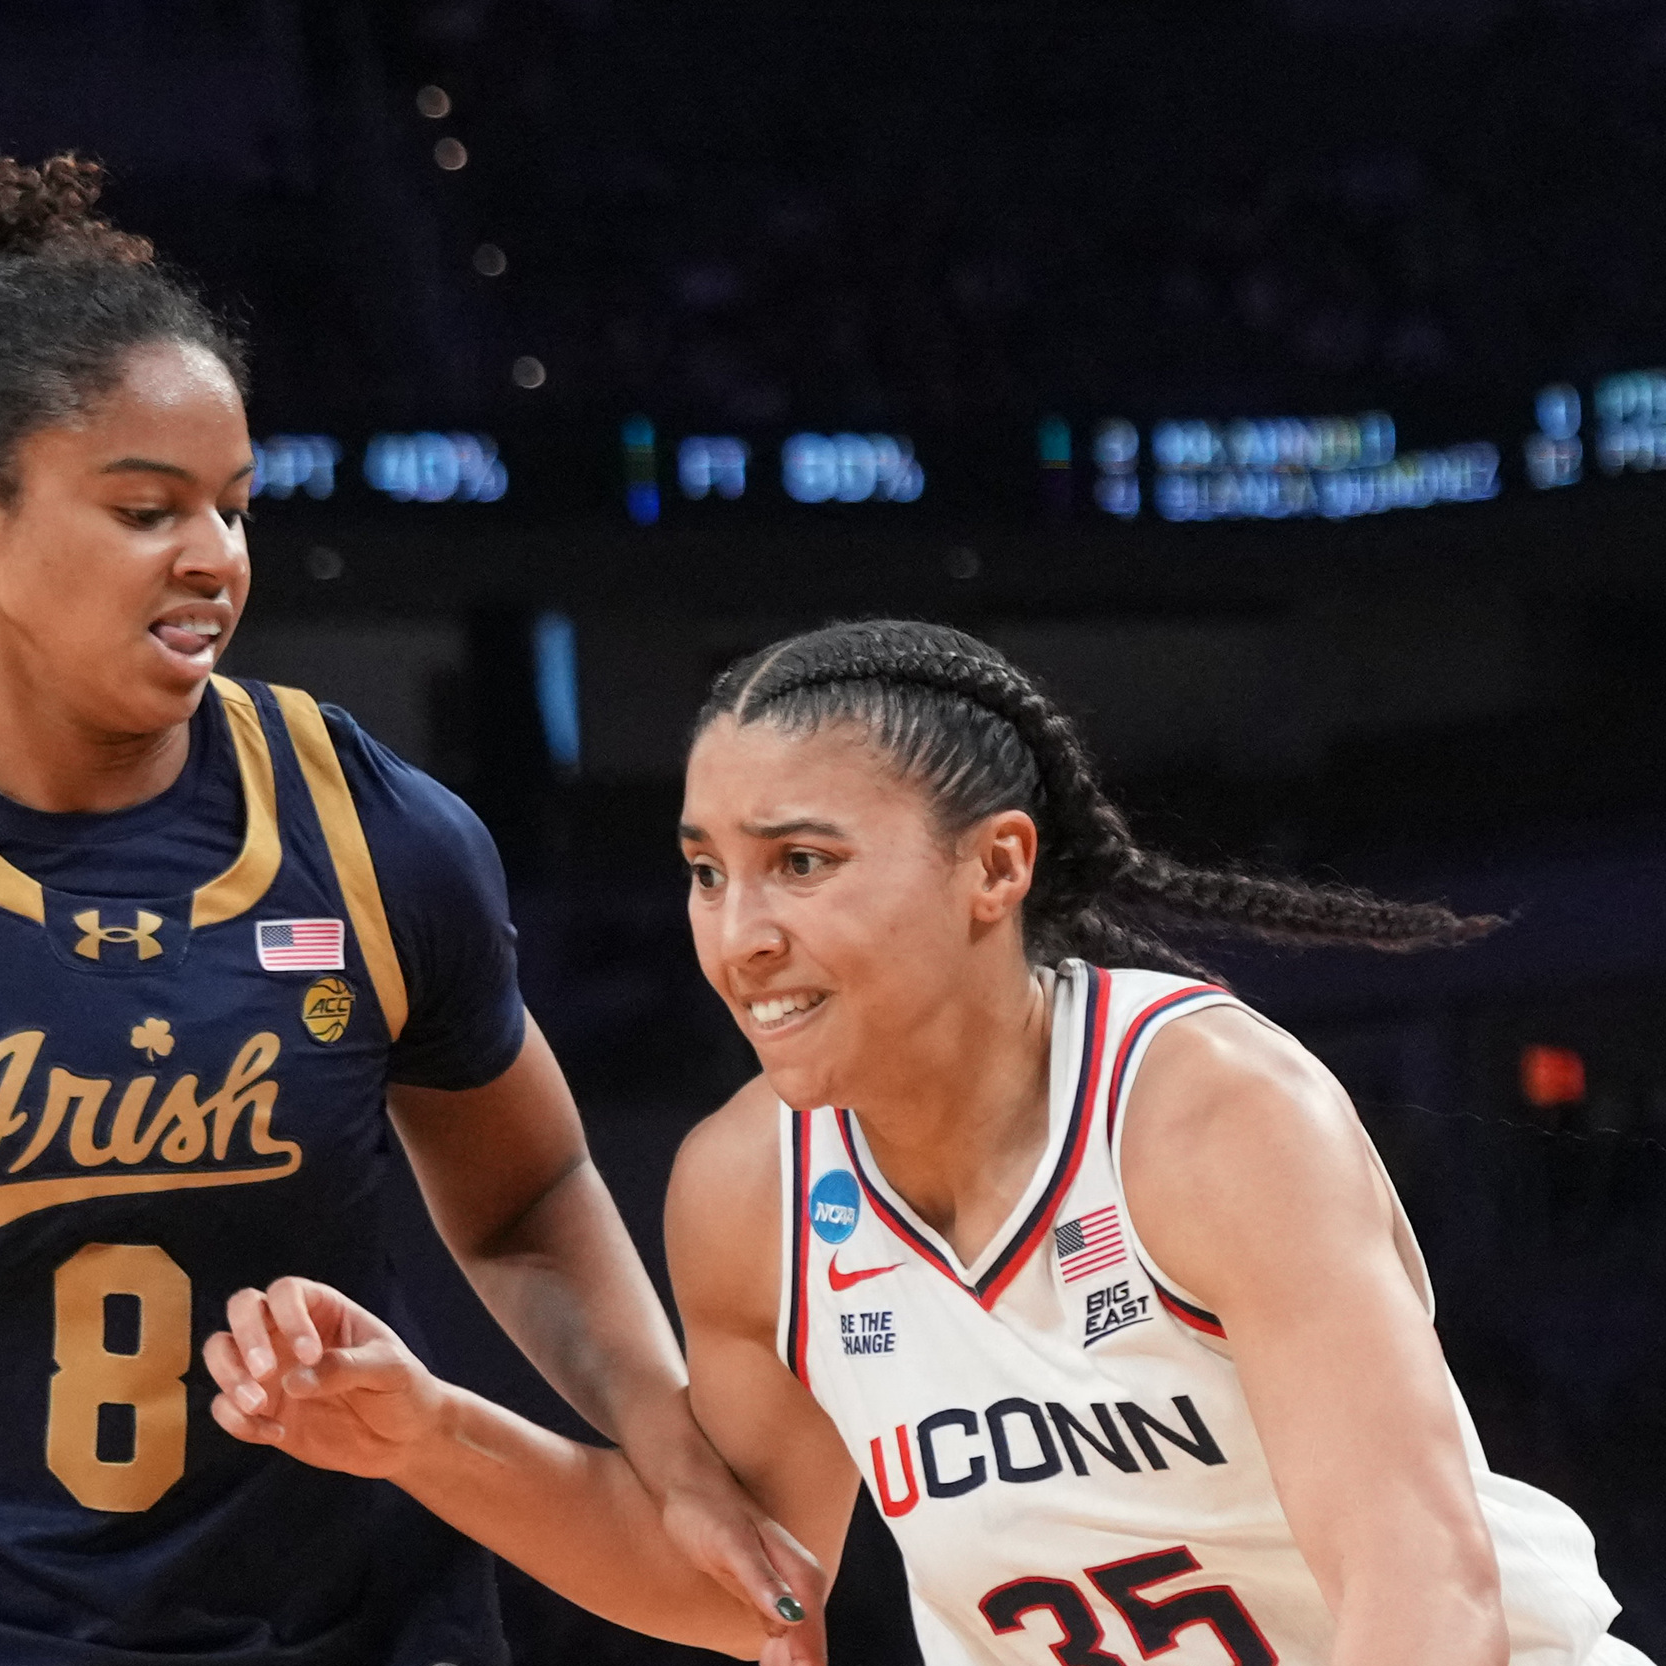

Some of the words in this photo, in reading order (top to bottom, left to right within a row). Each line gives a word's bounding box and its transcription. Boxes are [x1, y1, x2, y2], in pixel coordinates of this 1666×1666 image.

[308, 997, 351, 1015] ACC
[815, 1201, 857, 1228] NCAA
[1087, 1280, 1130, 1314] BIG
[840, 1314, 855, 1334] BE
[859, 1311, 893, 1333] THE
[1085, 1295, 1149, 1335] EAST
[46, 1242, 192, 1513] 8
[870, 1395, 1229, 1518] UCONN
